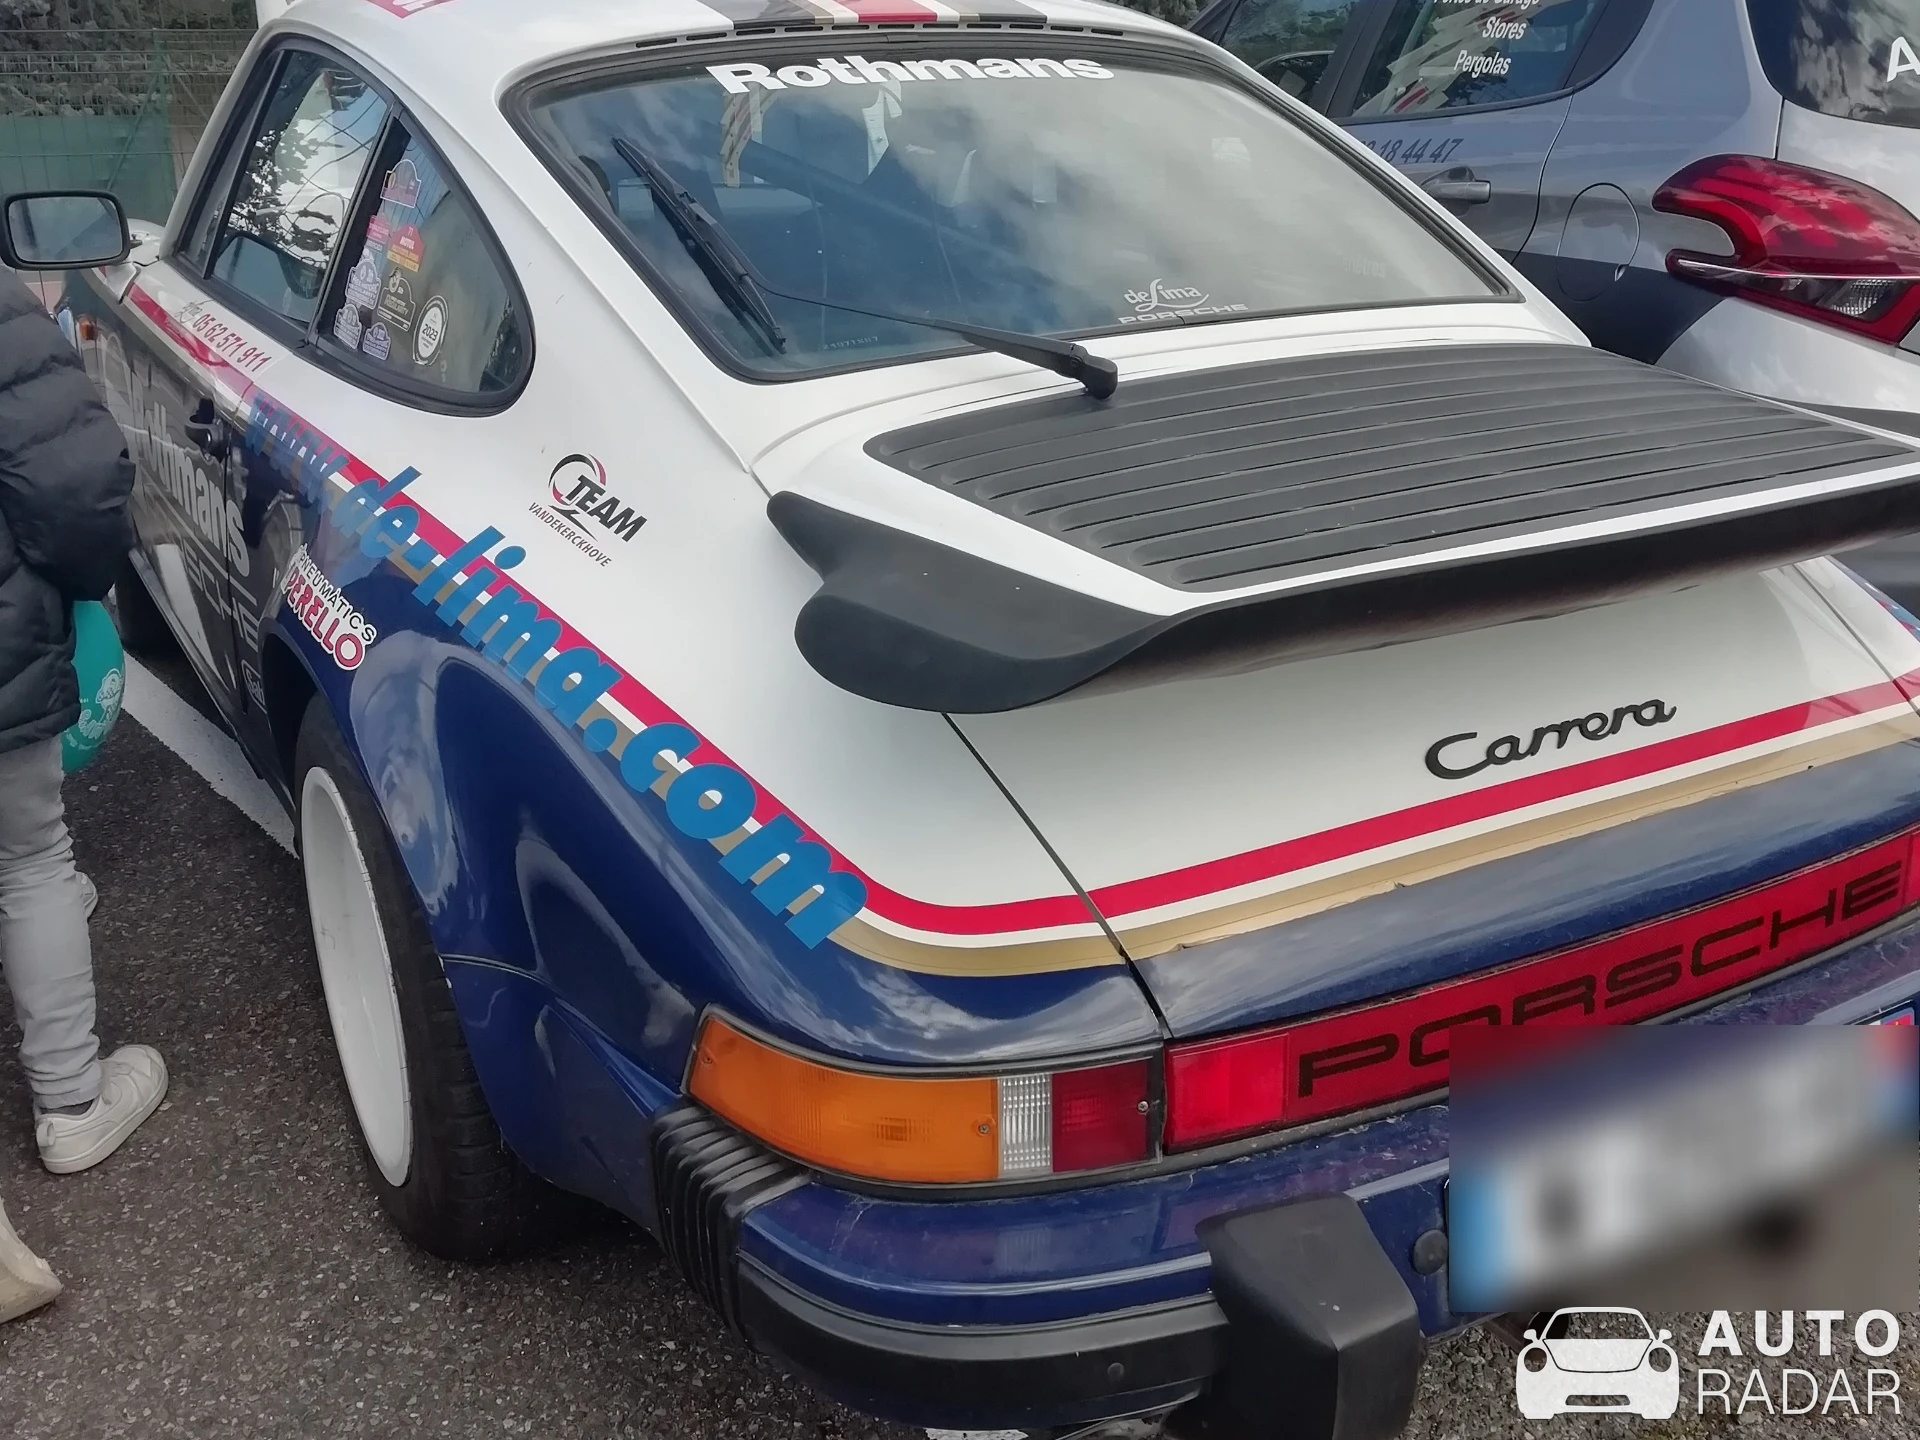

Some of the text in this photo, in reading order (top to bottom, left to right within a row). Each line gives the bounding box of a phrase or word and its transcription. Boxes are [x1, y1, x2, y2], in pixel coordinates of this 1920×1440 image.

[1482, 16, 1527, 40] Stores
[704, 55, 1115, 94] Rothmans
[1454, 49, 1512, 79] Pergolas
[1401, 138, 1432, 164] 44
[1429, 138, 1464, 163] 47
[421, 323, 439, 341] 2023
[1117, 303, 1249, 324] PORSCHE
[192, 313, 273, 373] 05 62 571 911
[564, 474, 648, 543] TEAM
[528, 502, 613, 568] VANDEKERCKHOVE
[283, 562, 364, 668] PERELLO
[1424, 698, 1677, 780] Carrera
[1297, 860, 1902, 1098] PORSCHE
